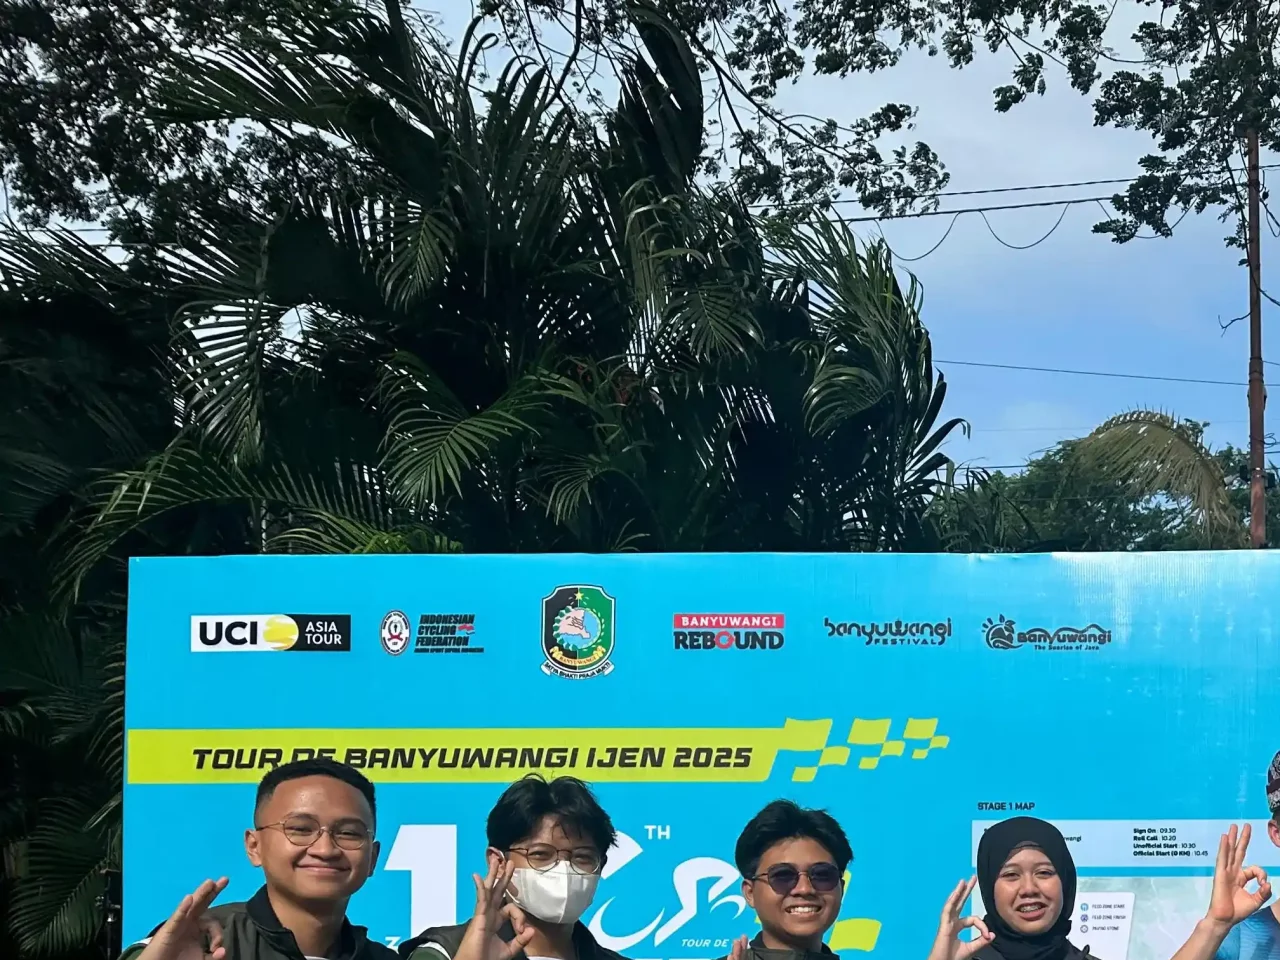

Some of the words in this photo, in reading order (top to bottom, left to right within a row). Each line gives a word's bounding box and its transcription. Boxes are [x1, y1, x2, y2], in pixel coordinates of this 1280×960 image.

[419, 614, 475, 624] INDONESIAN
[681, 616, 777, 626] BANYUWANGI
[305, 621, 338, 633] ASIA
[417, 625, 457, 635] CYCLING
[199, 621, 258, 646] UCI
[305, 633, 342, 645] TOUR
[1017, 624, 1112, 645] Banyuwangi
[415, 636, 470, 647] FEDERATION
[673, 631, 784, 650] REBOUND
[193, 748, 282, 769] TOUR
[344, 748, 579, 768] BANYUWANGI
[586, 747, 666, 768] IJEN
[673, 747, 753, 768] 2025
[977, 802, 1007, 810] STAGE
[1015, 802, 1035, 810] MAP
[644, 826, 671, 840] TH
[681, 939, 709, 948] TOUR
[713, 939, 728, 948] DE
